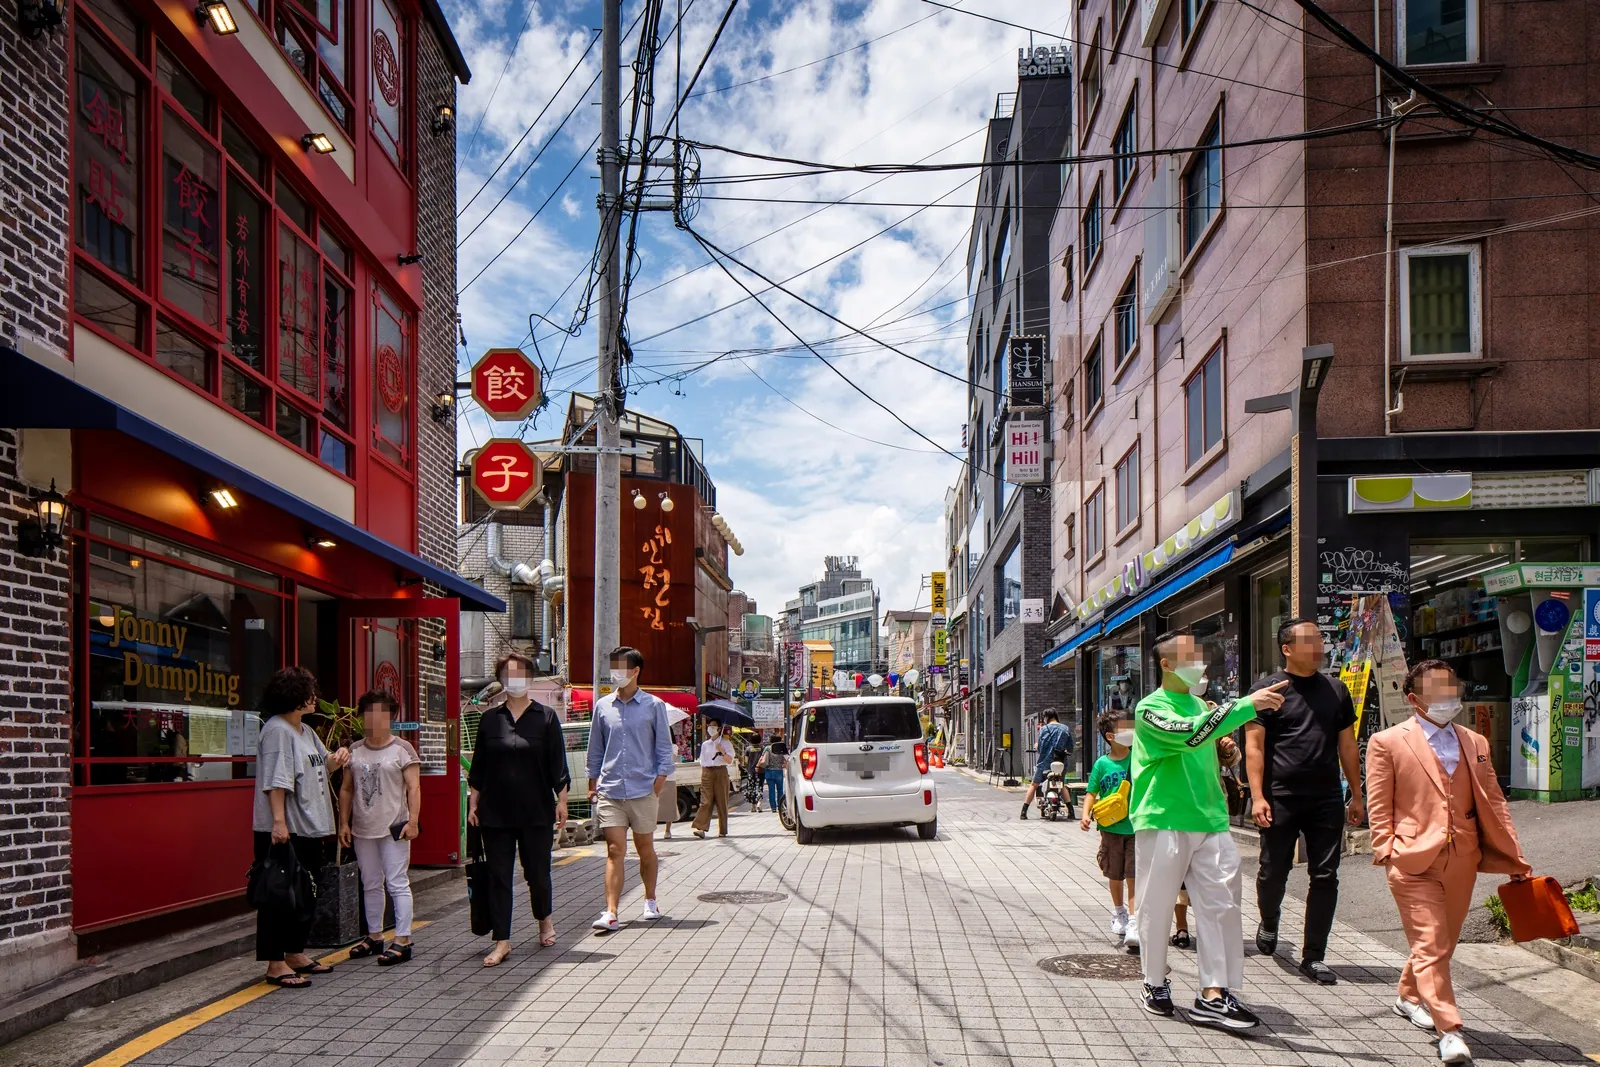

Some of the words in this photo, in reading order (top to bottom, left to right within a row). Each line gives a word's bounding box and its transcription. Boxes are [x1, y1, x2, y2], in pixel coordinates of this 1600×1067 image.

[173, 162, 212, 280] 餃子
[483, 365, 528, 401] 餃
[1012, 432, 1028, 446] Hi
[1012, 450, 1039, 465] Hill
[482, 455, 529, 493] 子
[1535, 570, 1580, 582] 현금지급기
[109, 605, 187, 658] Jonny
[123, 652, 240, 705] Dumpling
[1189, 701, 1233, 746] HOMME/FEMME
[878, 743, 901, 752] anycar
